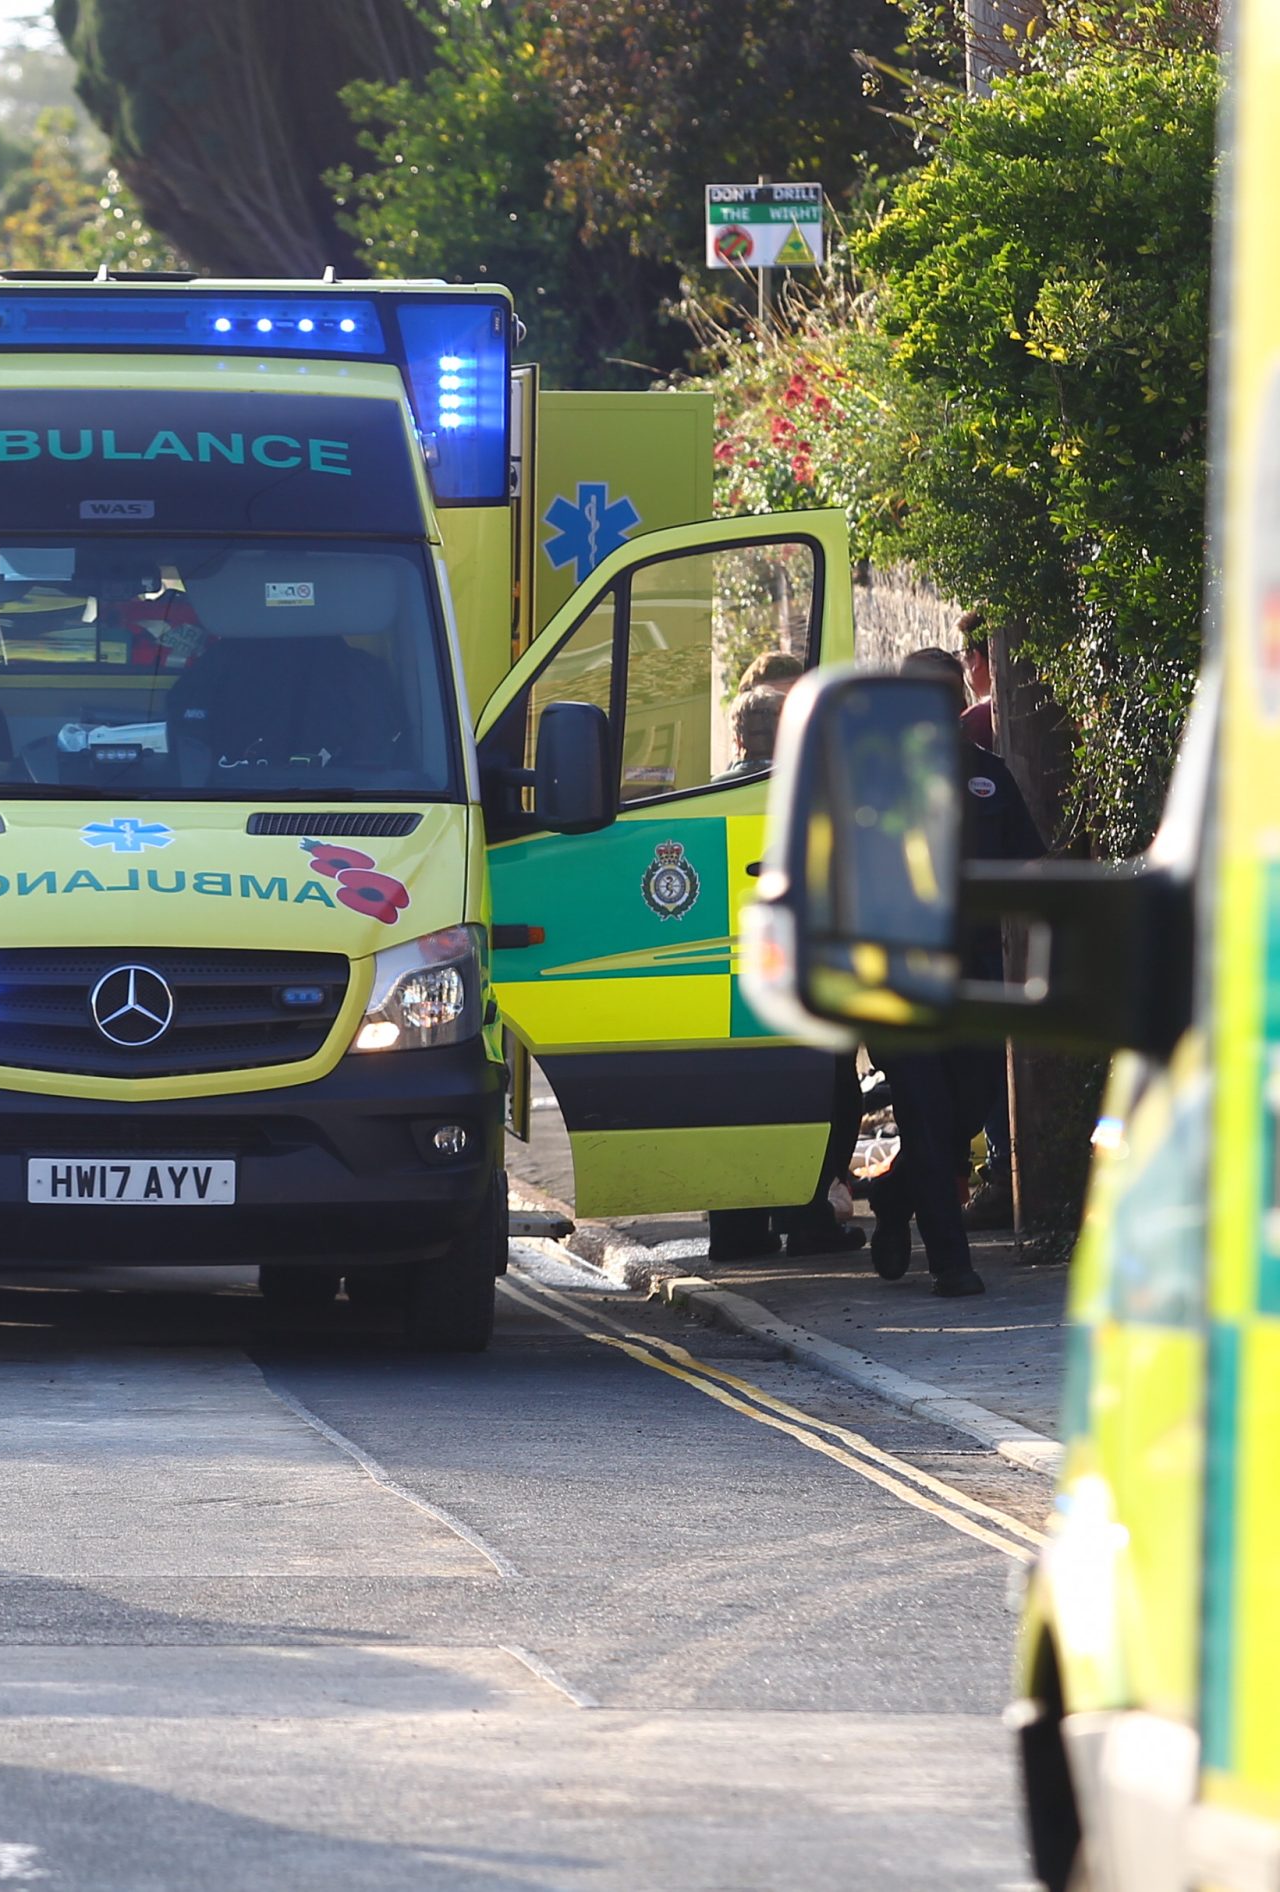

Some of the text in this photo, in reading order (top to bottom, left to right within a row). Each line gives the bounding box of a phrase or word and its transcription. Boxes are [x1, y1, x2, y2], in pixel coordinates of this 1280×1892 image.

[711, 187, 817, 201] DON'T DRILL
[721, 206, 819, 220] THE WIGHT
[90, 503, 142, 515] WAS
[51, 1165, 213, 1199] HW17 AYV
